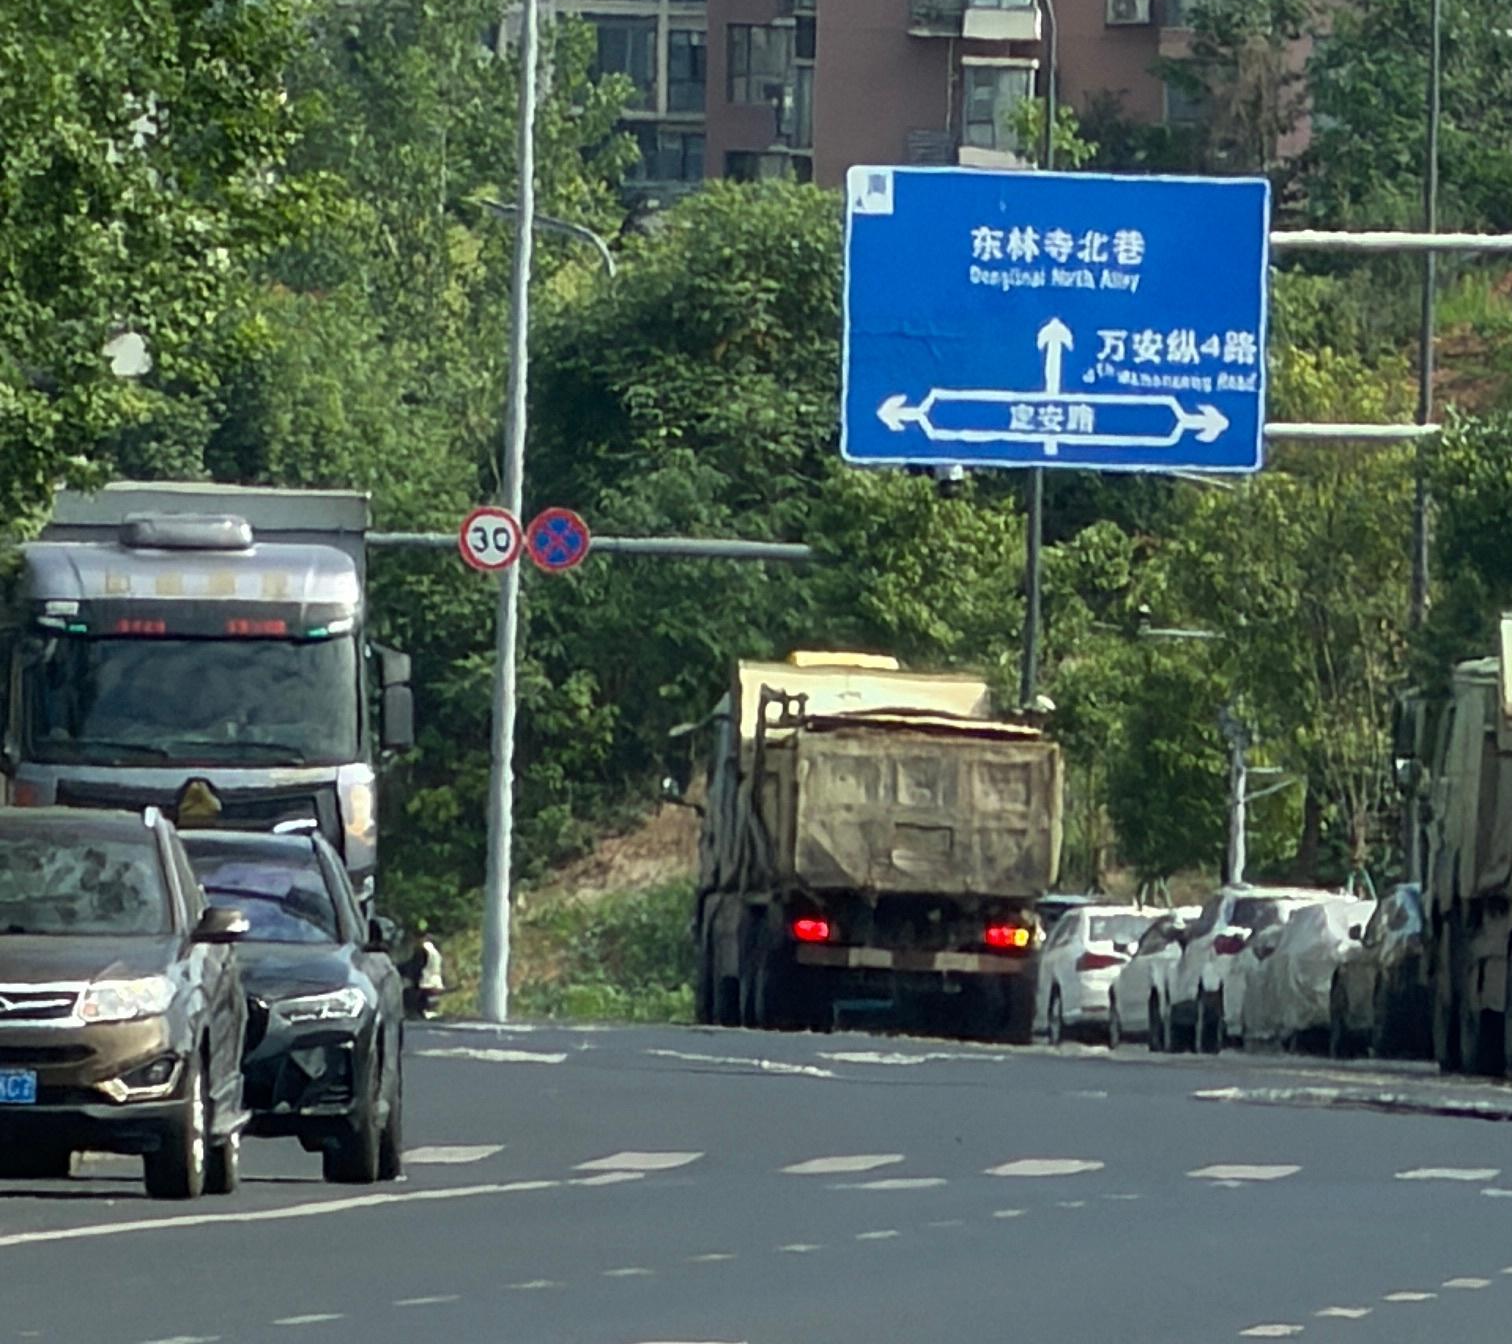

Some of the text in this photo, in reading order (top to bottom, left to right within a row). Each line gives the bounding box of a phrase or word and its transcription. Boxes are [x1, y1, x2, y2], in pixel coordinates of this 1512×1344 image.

[970, 225, 1146, 265] 东林寺北巷
[1051, 267, 1096, 290] North
[1099, 268, 1141, 294] Alley
[1096, 328, 1258, 365] 万安纵4路
[472, 526, 511, 553] 30
